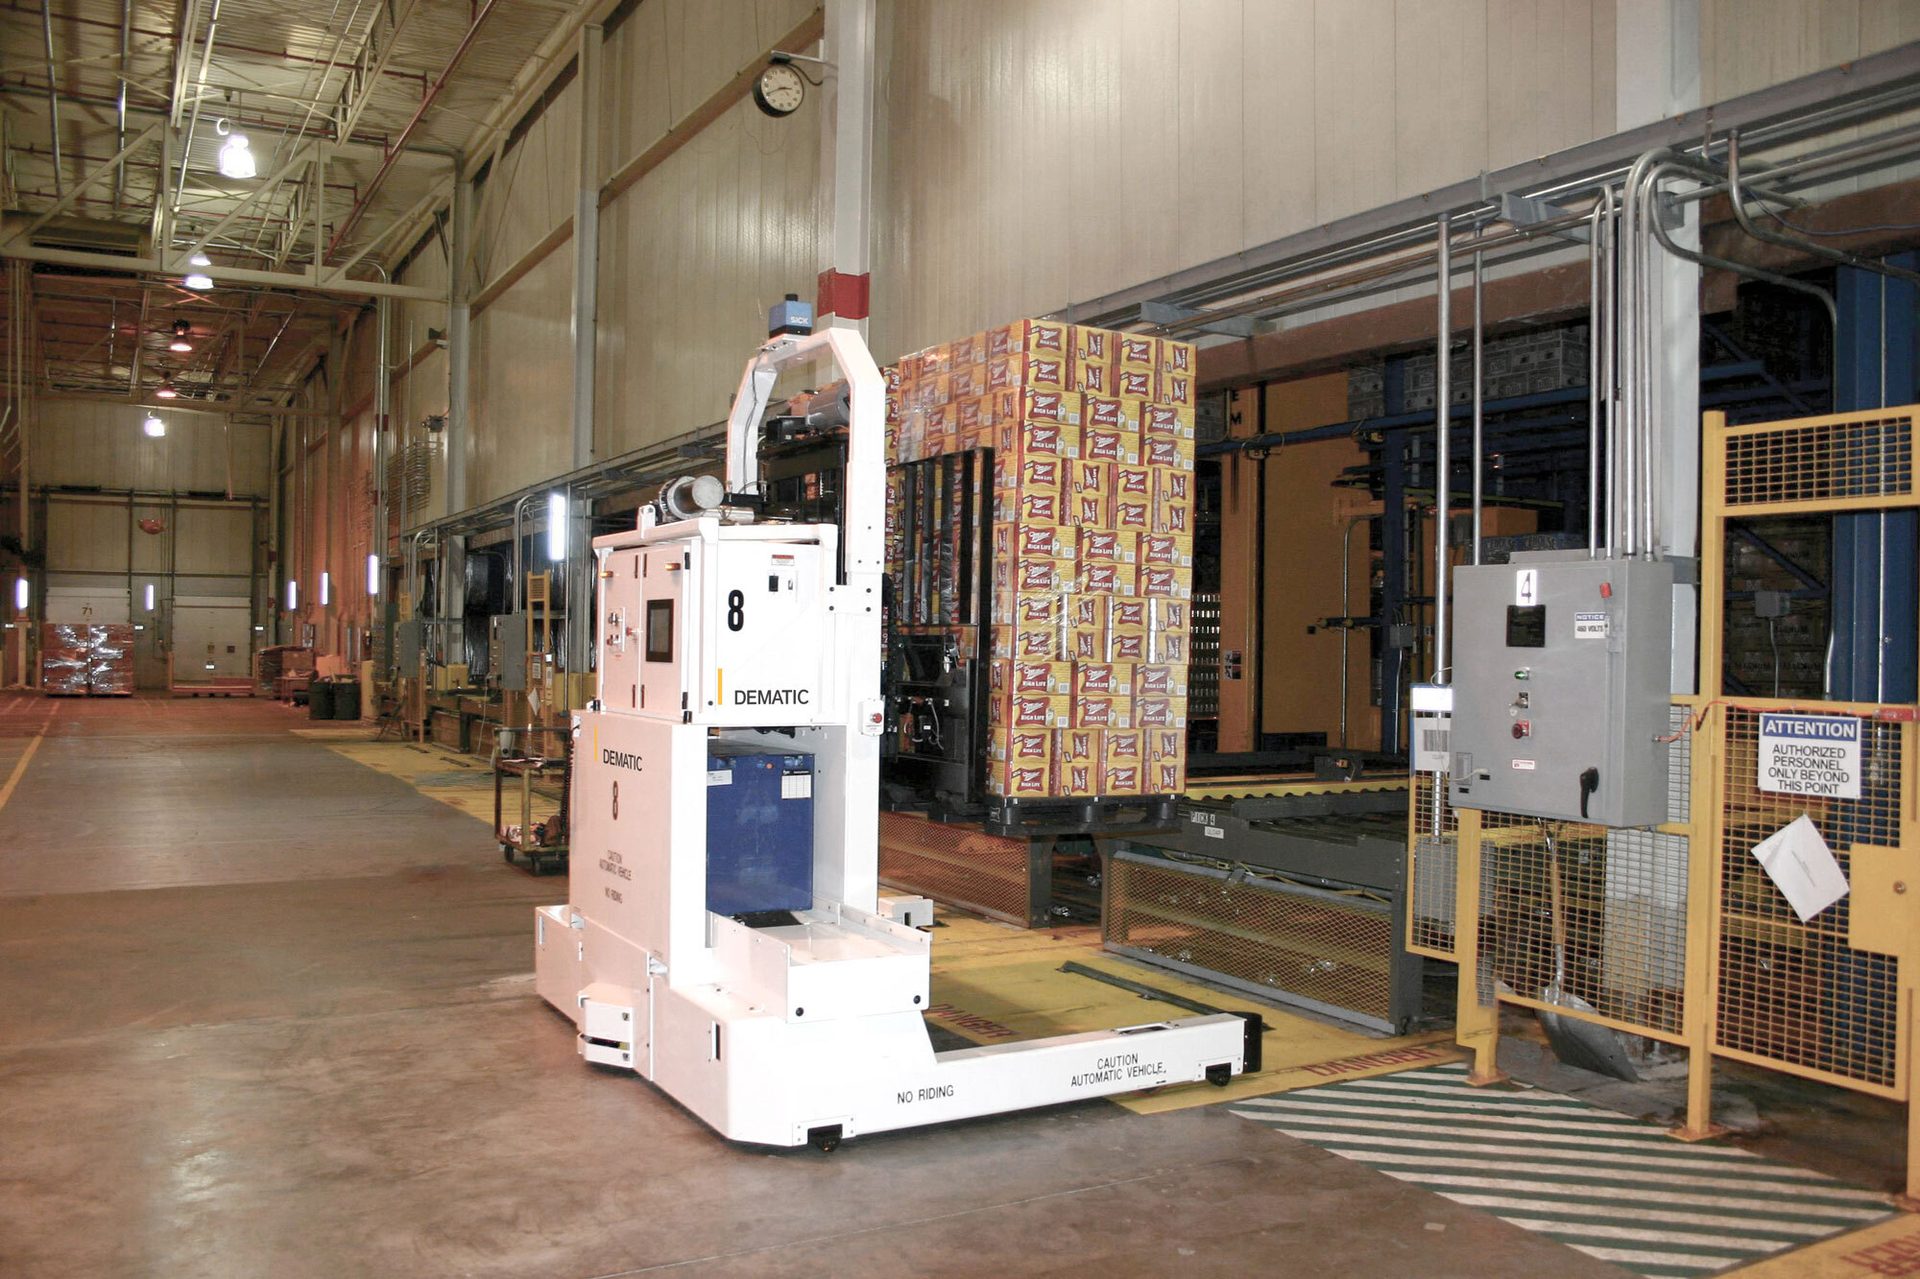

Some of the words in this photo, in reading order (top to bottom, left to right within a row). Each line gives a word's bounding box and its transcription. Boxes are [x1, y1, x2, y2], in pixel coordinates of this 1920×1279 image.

[1520, 571, 1532, 604] 4
[727, 589, 745, 632] 8
[734, 689, 809, 705] DEMATIC
[1765, 719, 1855, 738] ATTENTION
[603, 748, 643, 772] DEMATIC
[1772, 744, 1846, 759] AUTHORIZED
[1773, 756, 1843, 771] PERSONNEL
[1768, 767, 1798, 779] ONLY
[1800, 770, 1849, 783] BEYOND
[1778, 779, 1802, 791] THIS
[1804, 781, 1840, 794] POINT
[612, 780, 619, 820] 8
[1097, 1053, 1139, 1070] CAUTION
[1301, 1047, 1440, 1076] DANGER
[1071, 1069, 1123, 1087] AUTOMATIC
[897, 1092, 913, 1104] NO
[918, 1085, 954, 1102] RIDING
